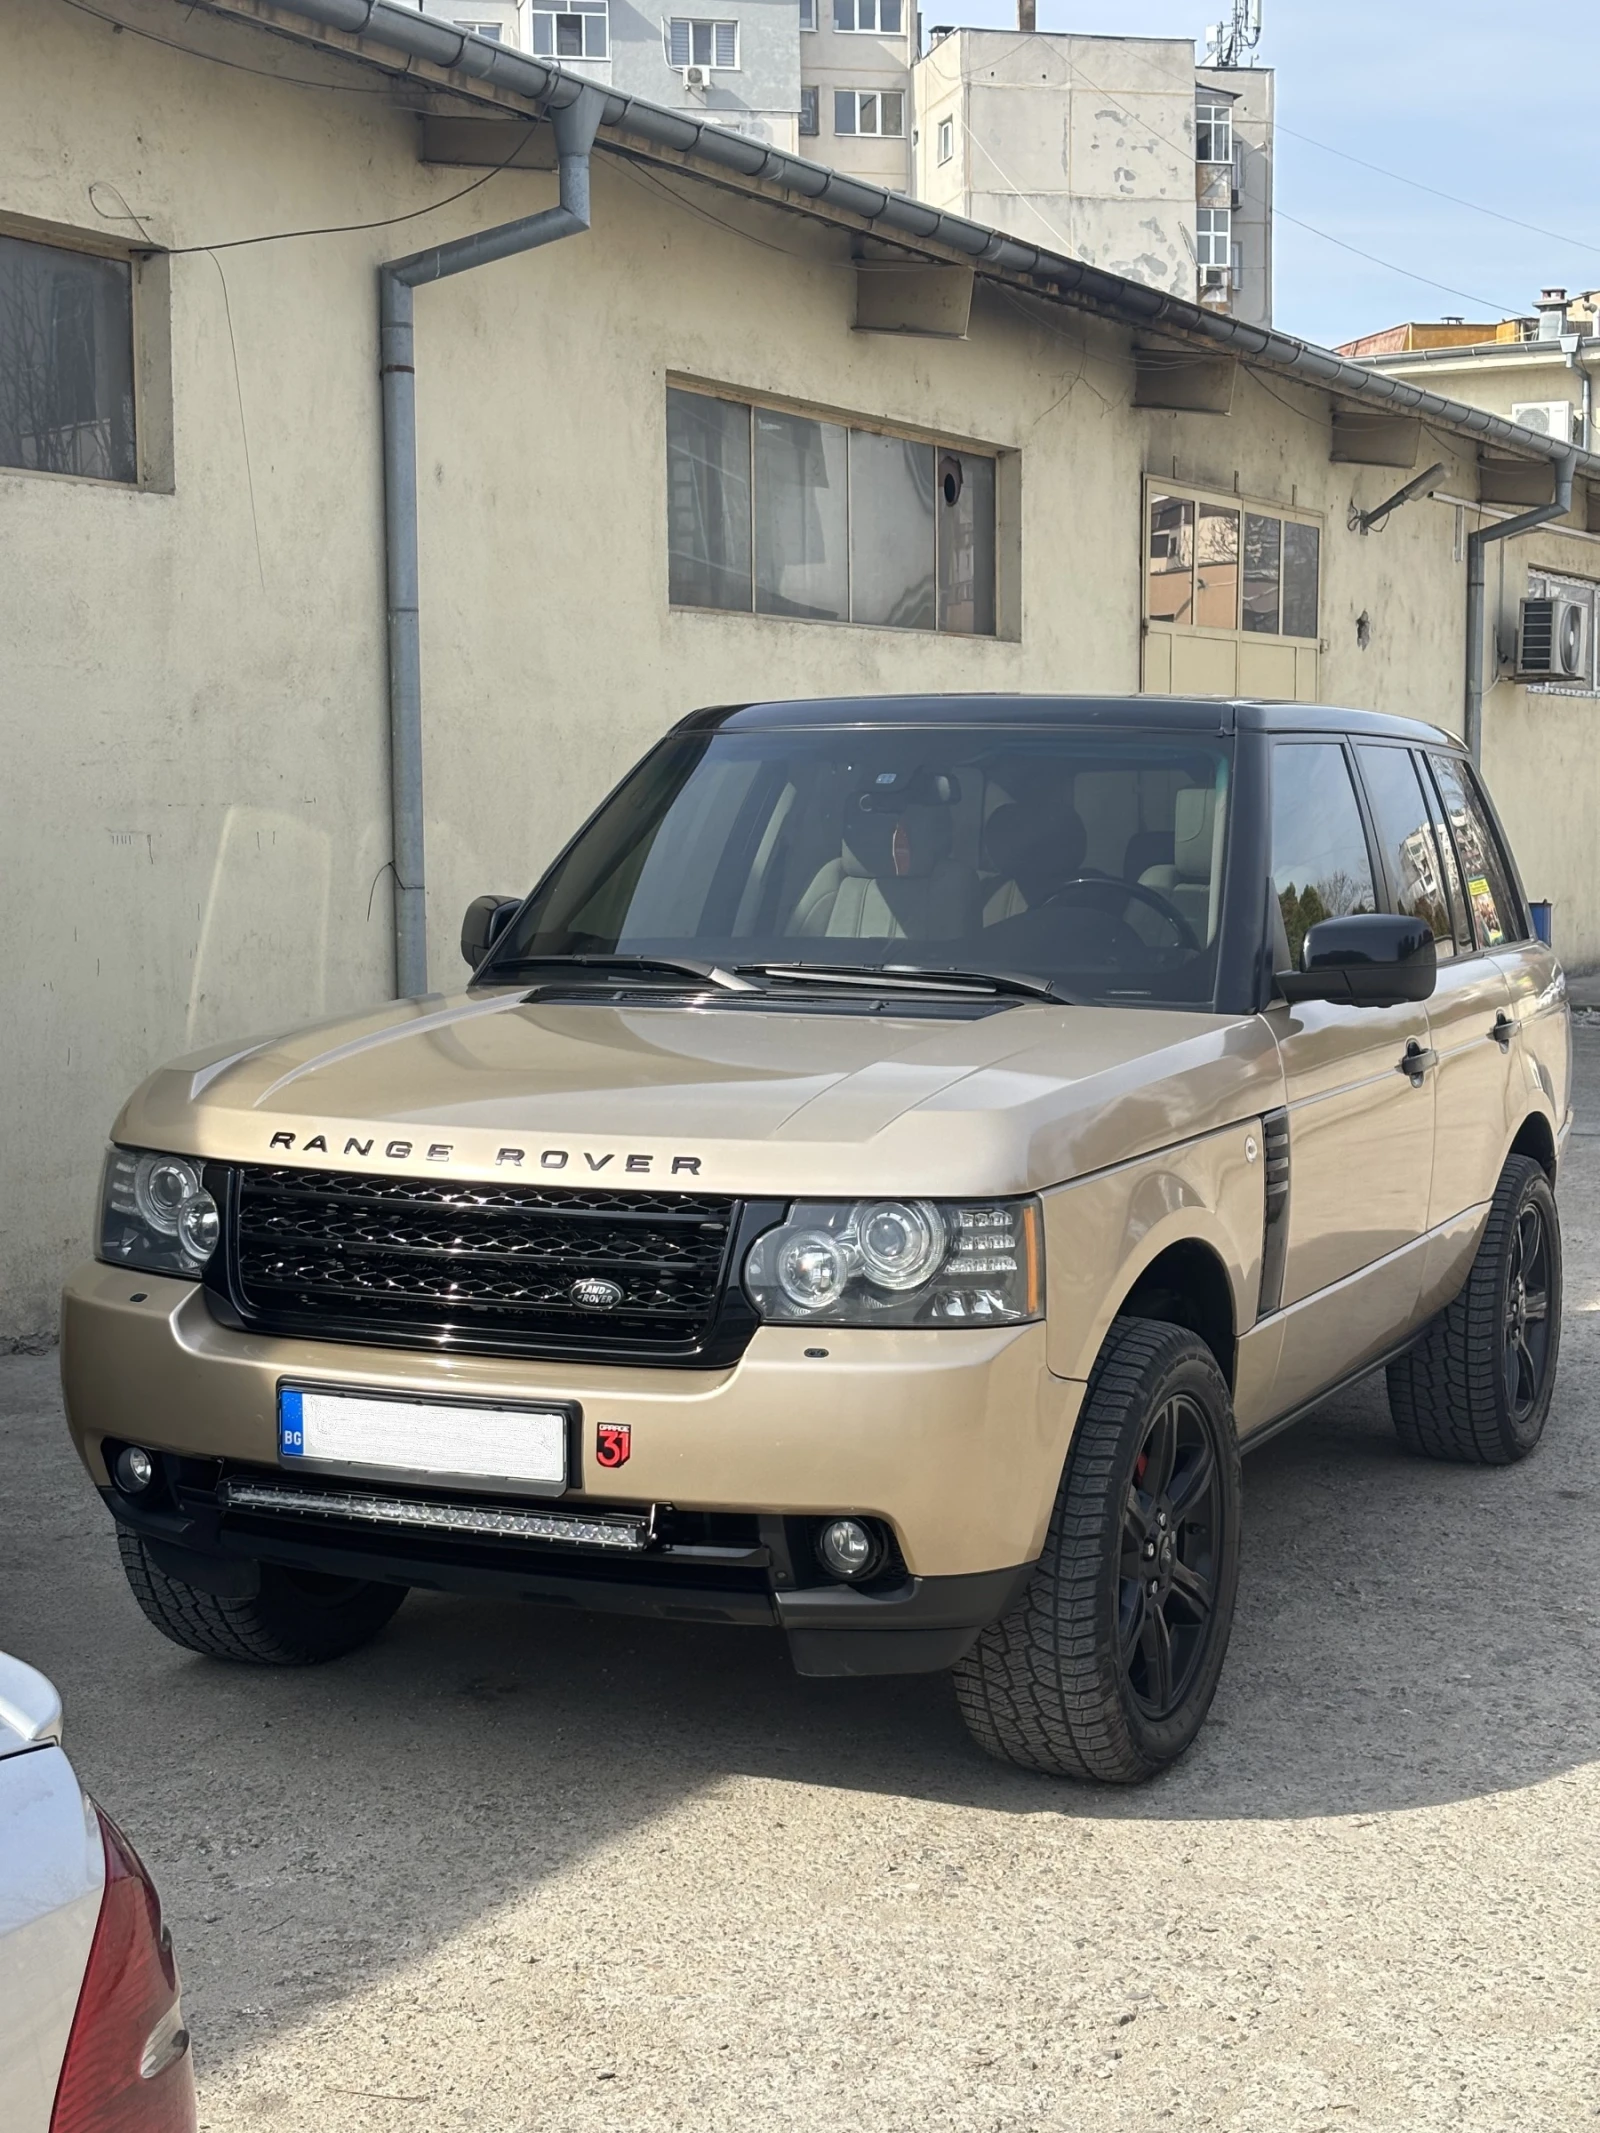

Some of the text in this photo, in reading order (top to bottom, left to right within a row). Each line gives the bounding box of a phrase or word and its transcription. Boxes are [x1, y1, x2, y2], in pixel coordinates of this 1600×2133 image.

[269, 1131, 702, 1176] RANGE ROVER
[580, 1284, 606, 1295] LAND
[581, 1294, 613, 1304] ROVER
[284, 1430, 302, 1446] BG
[597, 1431, 629, 1466] 31
